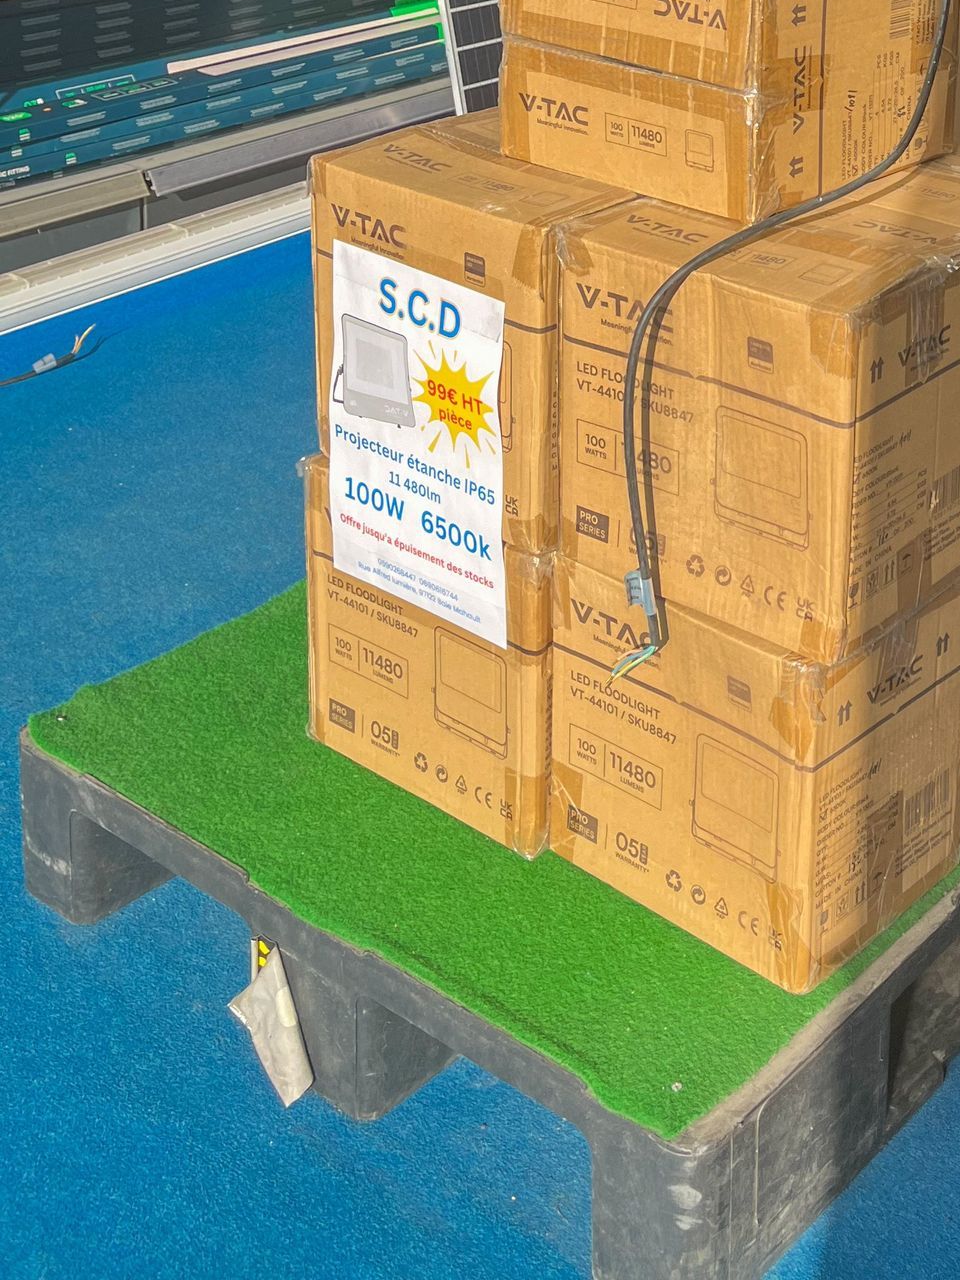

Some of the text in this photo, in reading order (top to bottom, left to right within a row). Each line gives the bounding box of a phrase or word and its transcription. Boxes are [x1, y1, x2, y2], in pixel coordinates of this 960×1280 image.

[792, 45, 807, 135] V-TAC
[518, 92, 589, 127] V-TAC
[610, 121, 624, 132] 100
[631, 125, 663, 144] 11480
[384, 143, 453, 172] V-TAC
[330, 202, 408, 249] V-TAC
[626, 214, 709, 244] V-TAC
[379, 276, 461, 339] S.C.D
[576, 360, 599, 376] LED
[427, 379, 483, 416] 99€ HT
[641, 397, 694, 424] SKU8847
[438, 408, 473, 431] pièce
[584, 446, 607, 460] WATTS
[585, 433, 606, 450] 100
[334, 423, 495, 506] Projecteur étanche IP65
[344, 476, 493, 562] 100W 6500k
[578, 521, 606, 540] SERIES
[580, 511, 599, 525] PRO
[339, 512, 361, 531] Offre
[394, 536, 445, 570] épuisement
[446, 559, 463, 577] des
[464, 569, 495, 590] stocks
[327, 574, 404, 616] LED FLOODLIGHT
[327, 589, 370, 616] VT-44101
[376, 611, 419, 639] SKU8847
[334, 636, 352, 652] 100
[362, 647, 404, 680] 11480
[570, 670, 661, 720] LED FLOODLIGHT
[331, 702, 347, 717] PRO
[570, 685, 619, 717] VT-44101
[627, 714, 677, 745] SKU8847
[370, 720, 391, 744] 05
[576, 750, 598, 766] WATTS
[577, 737, 597, 756] 100
[609, 751, 657, 789] 11480
[619, 775, 645, 794] LUMENS
[569, 820, 595, 841] SERIES
[615, 831, 639, 859] 05
